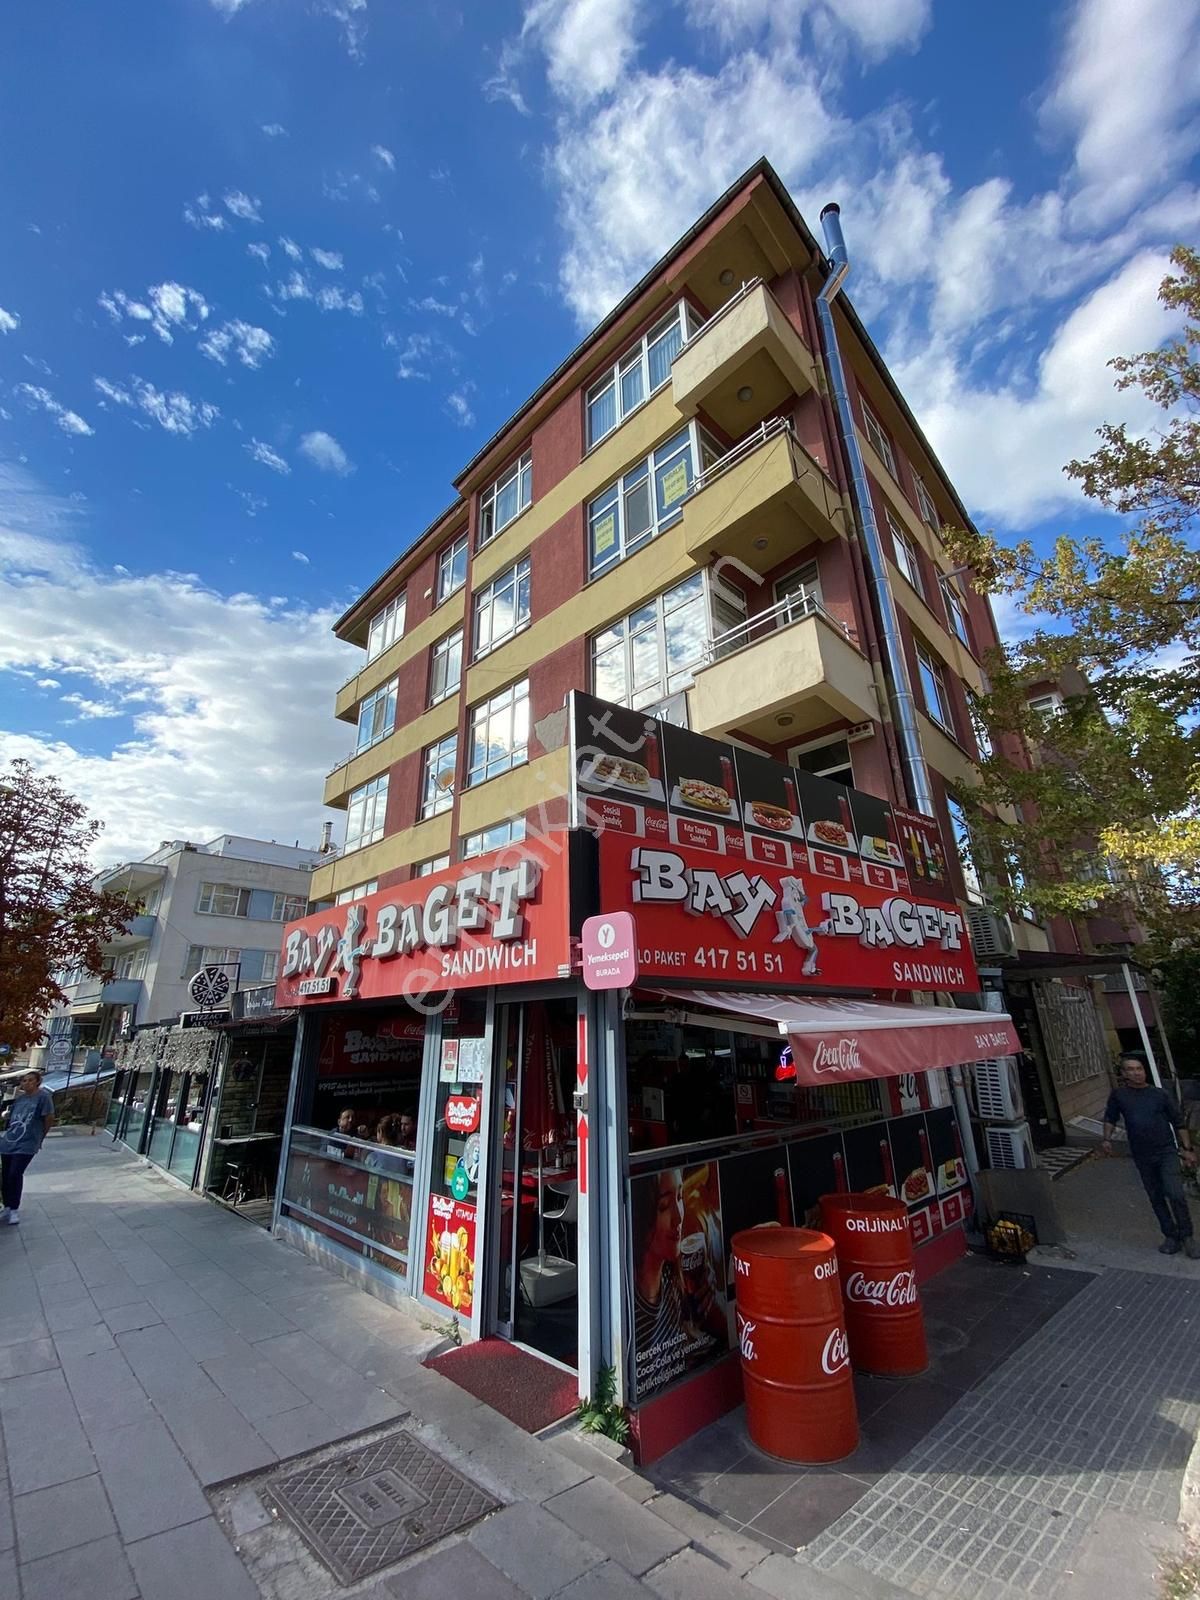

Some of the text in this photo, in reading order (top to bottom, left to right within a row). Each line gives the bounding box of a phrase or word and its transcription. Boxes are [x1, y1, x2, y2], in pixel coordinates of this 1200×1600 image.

[631, 847, 777, 940] BAY
[372, 860, 539, 958] BAGET
[822, 891, 963, 951] BAGET
[282, 925, 338, 978] BAY
[441, 939, 537, 977] SANDWICH
[587, 949, 629, 966] Yemeksepeti
[637, 947, 783, 974] LO PAKET 417 51 51
[312, 981, 320, 992] 51
[321, 979, 329, 991] 51
[596, 967, 621, 977] BURADA
[893, 961, 965, 986] SANDWICH
[974, 1034, 989, 1049] BAY
[812, 1038, 861, 1074] Coca-Cola
[845, 1217, 903, 1233] ORİJİNAL
[846, 1269, 918, 1307] Coca-Cola
[635, 1343, 662, 1363] Gerçek
[636, 1354, 672, 1378] Coca-Cola
[672, 1351, 681, 1360] ve
